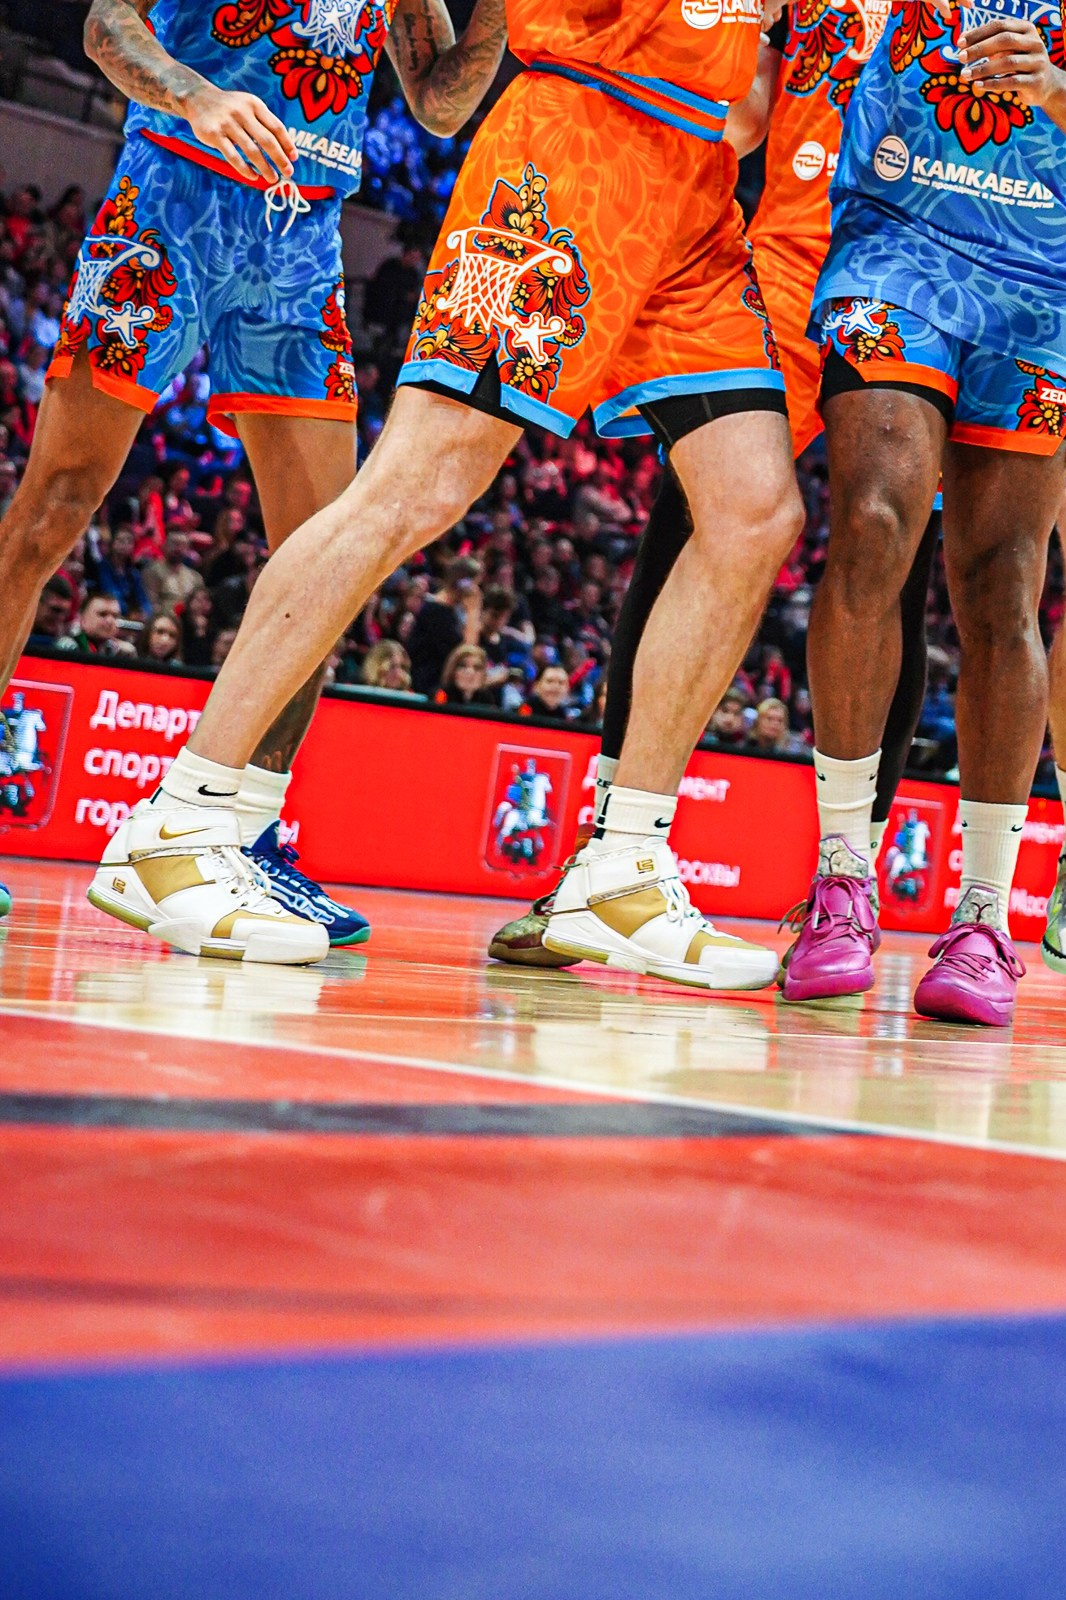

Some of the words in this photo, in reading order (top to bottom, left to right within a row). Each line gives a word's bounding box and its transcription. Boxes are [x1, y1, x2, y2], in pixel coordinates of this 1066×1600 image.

[288, 126, 363, 169] МКАБЕЛЬ
[912, 155, 1054, 201] КАМКАБЕЛЬ
[89, 689, 202, 742] Департ
[83, 747, 175, 790] спорт
